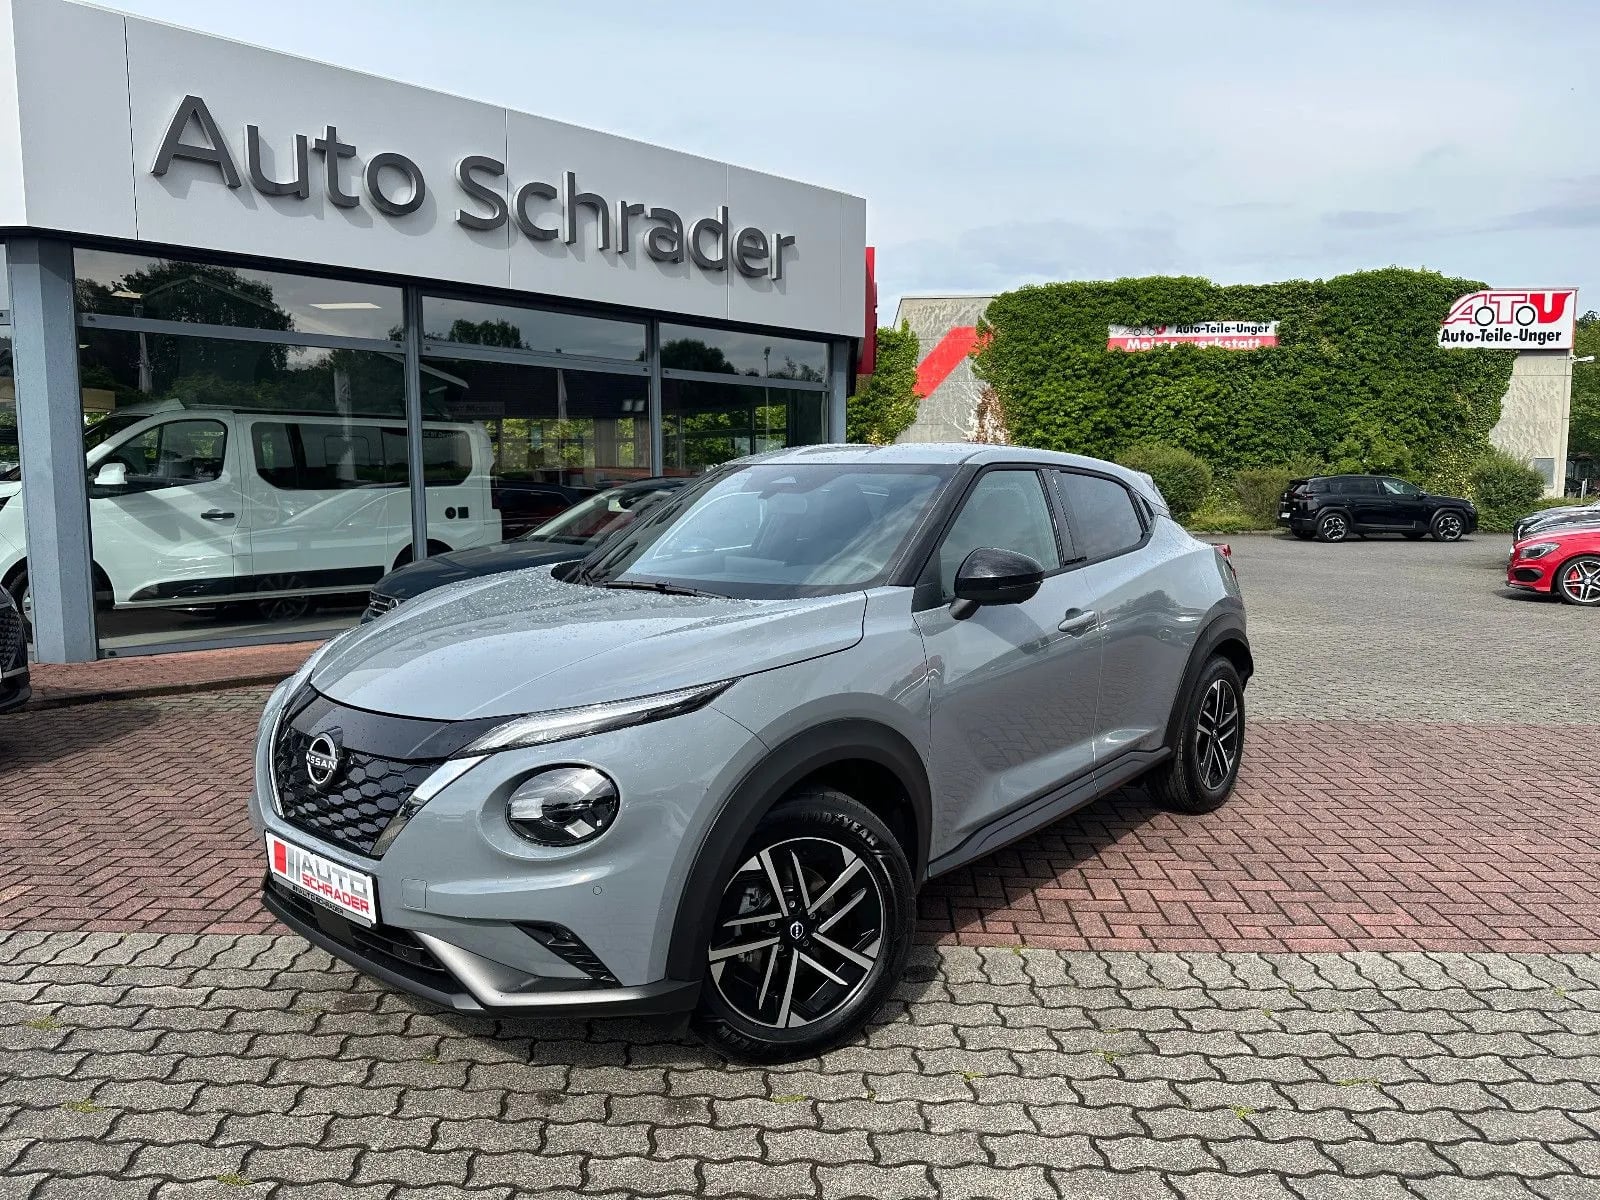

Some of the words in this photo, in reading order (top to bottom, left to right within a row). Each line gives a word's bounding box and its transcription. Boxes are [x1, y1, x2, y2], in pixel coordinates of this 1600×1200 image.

[150, 94, 426, 217] Auto
[454, 154, 796, 281] Schrader
[1175, 322, 1270, 336] Auto-Teile-Unger
[1440, 328, 1562, 345] Auto-Teile-Unger
[301, 854, 368, 899] AUTO
[301, 873, 370, 914] SCHRADER
